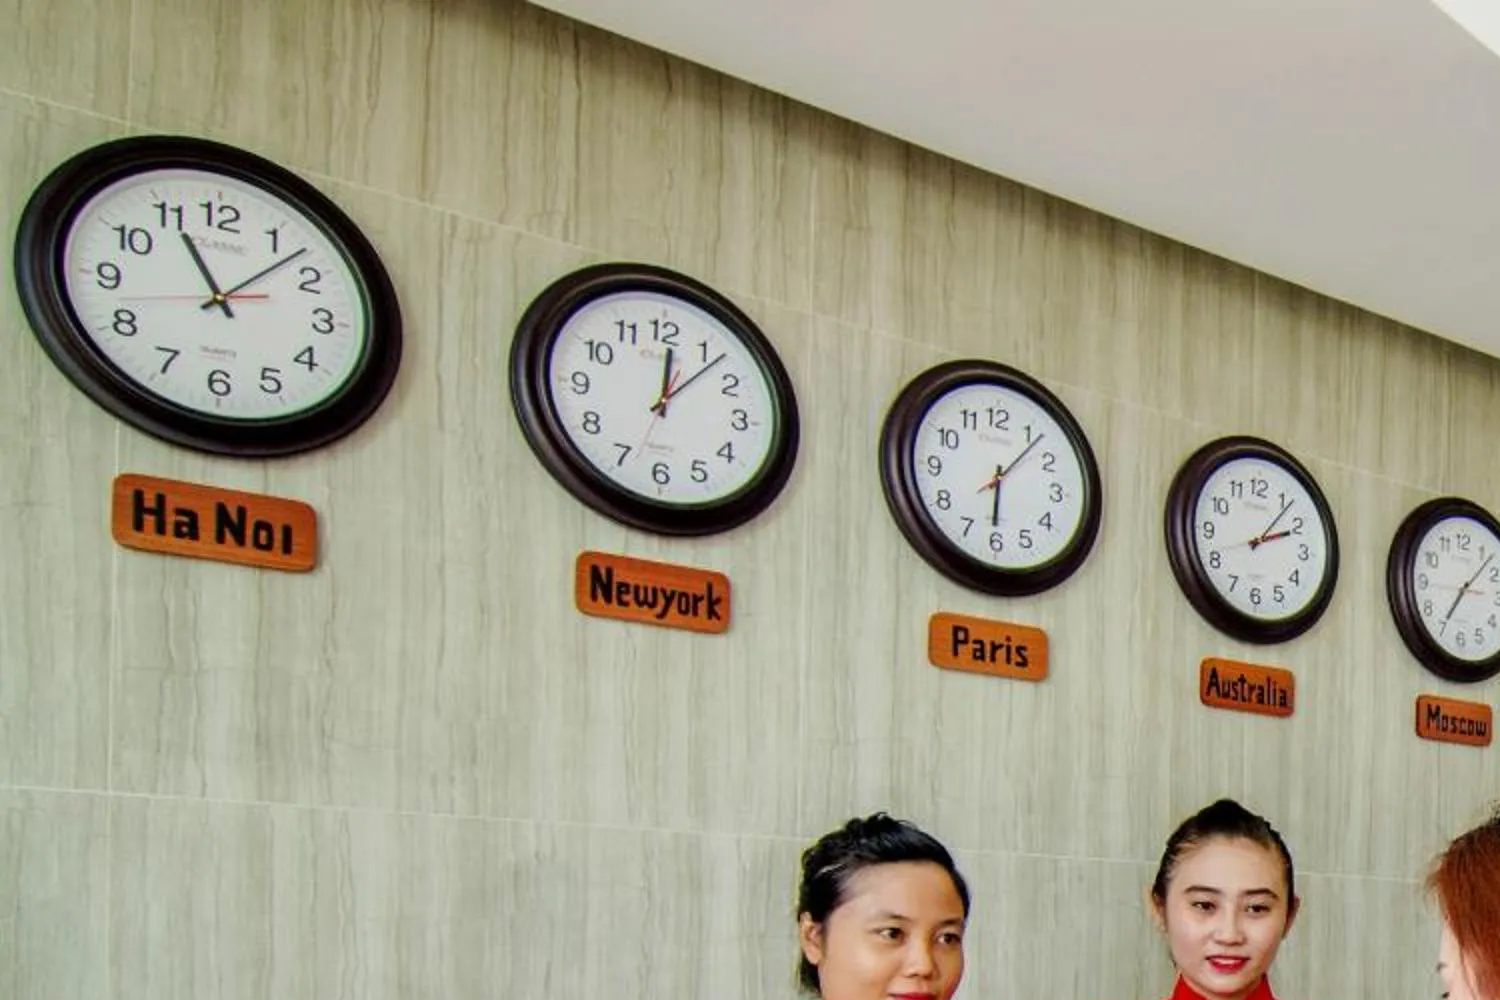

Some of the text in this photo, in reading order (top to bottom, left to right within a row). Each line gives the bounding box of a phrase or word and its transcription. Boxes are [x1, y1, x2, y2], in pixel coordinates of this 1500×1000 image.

[153, 202, 183, 231] 11
[200, 202, 240, 233] 12
[112, 225, 152, 255] 10
[265, 229, 277, 253] 1
[96, 262, 122, 290] 9
[299, 267, 320, 294] 2
[113, 309, 137, 336] 8
[312, 308, 334, 334] 3
[614, 320, 637, 345] 11
[650, 319, 680, 346] 12
[155, 346, 180, 374] 7
[294, 346, 318, 371] 4
[585, 340, 613, 364] 10
[698, 340, 707, 363] 1
[208, 370, 230, 396] 6
[260, 368, 282, 394] 5
[572, 372, 590, 394] 9
[722, 374, 739, 396] 2
[582, 412, 600, 434] 8
[732, 410, 748, 431] 3
[960, 410, 977, 431] 11
[986, 407, 1009, 430] 12
[938, 428, 958, 448] 10
[1024, 425, 1031, 443] 1
[614, 444, 631, 466] 7
[717, 442, 734, 463] 4
[1042, 452, 1055, 472] 2
[652, 463, 670, 484] 6
[691, 460, 708, 482] 5
[928, 456, 942, 476] 9
[1050, 483, 1062, 502] 3
[1230, 480, 1243, 499] 11
[1251, 478, 1268, 498] 12
[936, 490, 951, 510] 8
[1212, 496, 1228, 515] 10
[1279, 492, 1285, 509] 1
[133, 489, 200, 541] Ha
[1039, 512, 1052, 530] 4
[961, 517, 974, 536] 7
[1204, 521, 1214, 540] 9
[1292, 518, 1303, 535] 2
[990, 532, 1002, 552] 6
[1019, 529, 1032, 548] 5
[1438, 537, 1450, 553] 11
[1456, 534, 1470, 550] 12
[1210, 551, 1221, 569] 8
[1298, 544, 1309, 561] 3
[1425, 551, 1438, 568] 10
[1228, 575, 1238, 592] 7
[1289, 570, 1299, 586] 4
[1418, 573, 1428, 590] 9
[1490, 567, 1498, 582] 2
[590, 564, 722, 620] Newyork
[1250, 588, 1260, 605] 6
[1274, 586, 1284, 602] 5
[1423, 600, 1432, 617] 8
[1439, 620, 1447, 637] 7
[1488, 614, 1496, 628] 4
[952, 625, 1029, 668] Paris
[1456, 632, 1465, 648] 6
[1475, 628, 1484, 645] 5
[1206, 667, 1288, 708] Australia
[1427, 703, 1487, 737] Moscow
